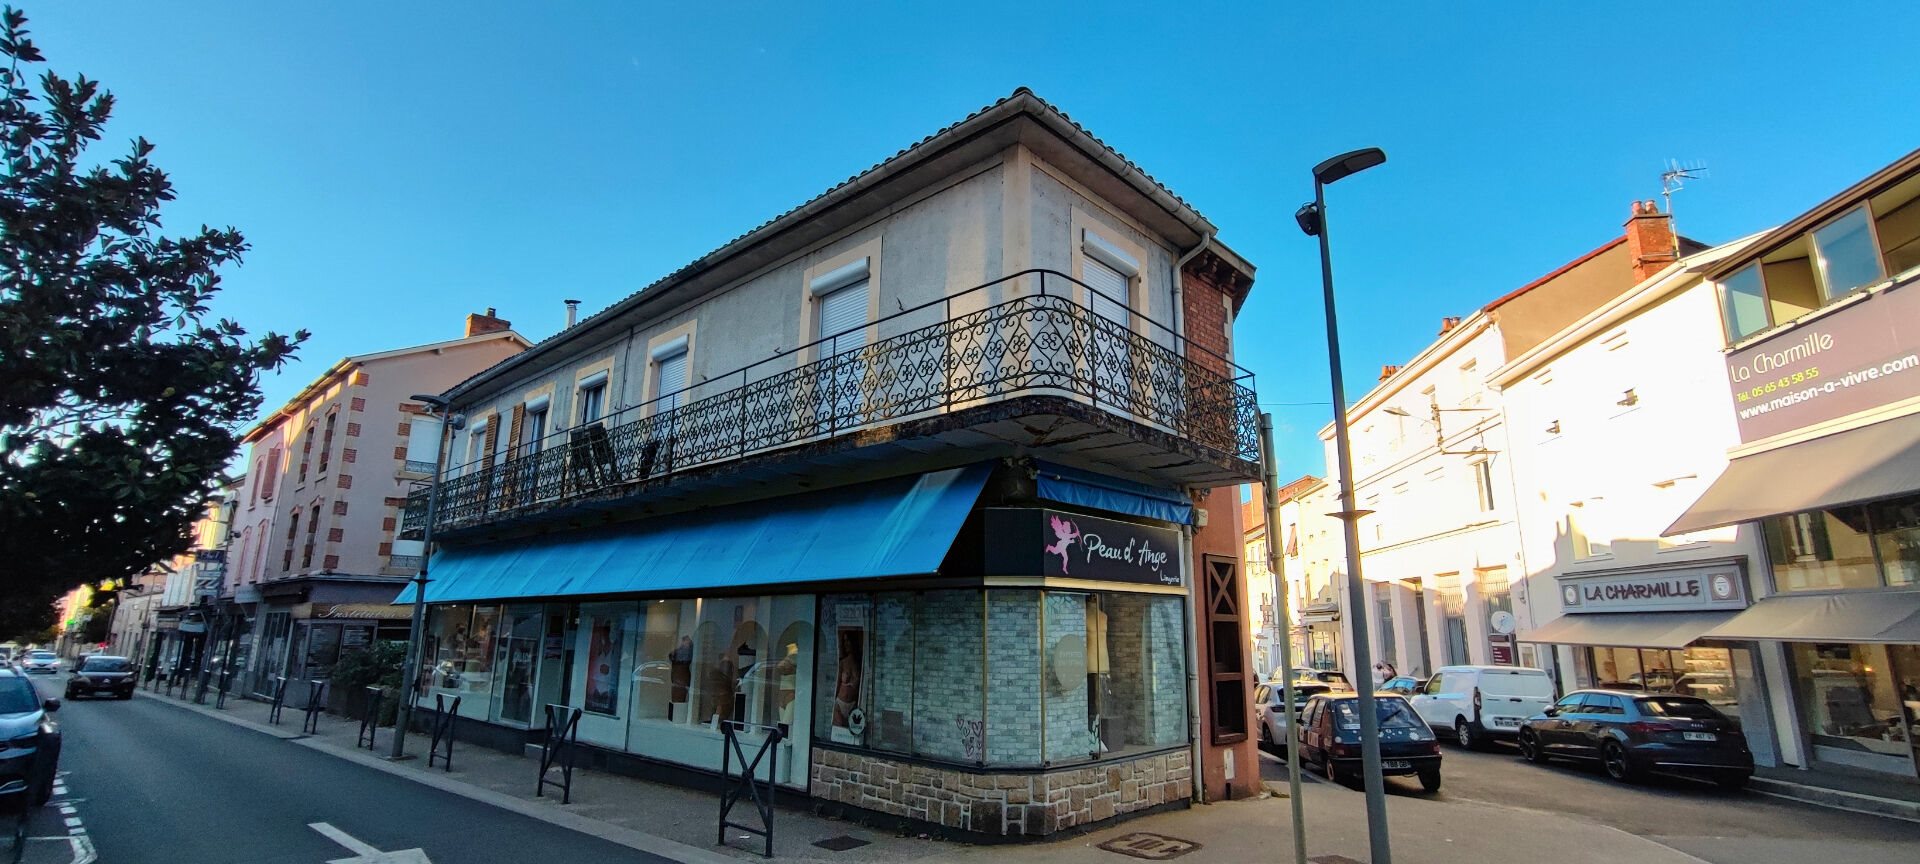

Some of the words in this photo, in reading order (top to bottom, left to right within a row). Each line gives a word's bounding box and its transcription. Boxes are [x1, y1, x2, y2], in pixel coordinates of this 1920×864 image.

[1731, 365, 1750, 383] La
[1753, 332, 1834, 374] Charmille
[1739, 353, 1919, 420] www.maison-a-vivre.com
[1752, 385, 1764, 398] 05
[1765, 381, 1777, 394] 65
[1778, 376, 1790, 389] 43
[1791, 371, 1804, 384] 58
[1806, 366, 1820, 380] 55
[1083, 533, 1122, 563] Peau
[1584, 586, 1605, 601] LA
[1605, 580, 1699, 600] CHARMILLE
